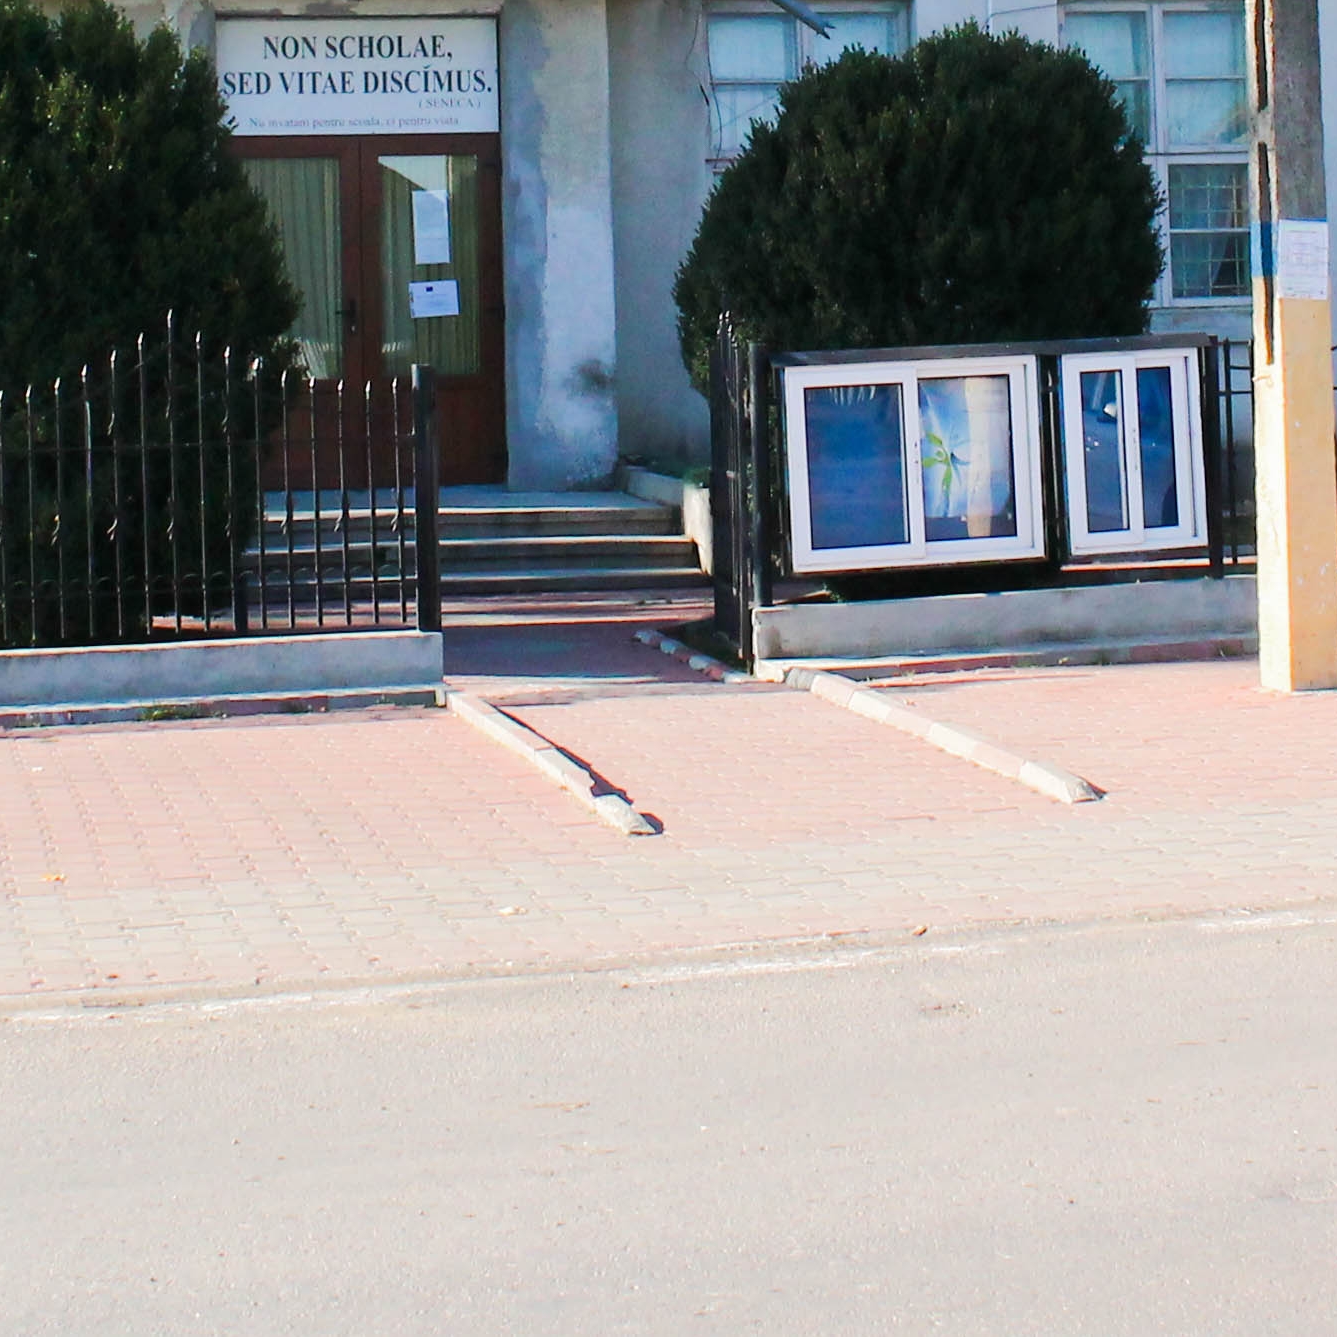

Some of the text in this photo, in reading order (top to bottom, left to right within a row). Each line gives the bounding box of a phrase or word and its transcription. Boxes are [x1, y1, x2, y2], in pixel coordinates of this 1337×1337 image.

[263, 35, 453, 62] NON SCHOLAE,
[222, 71, 271, 95] SED
[279, 71, 355, 94] VITAE
